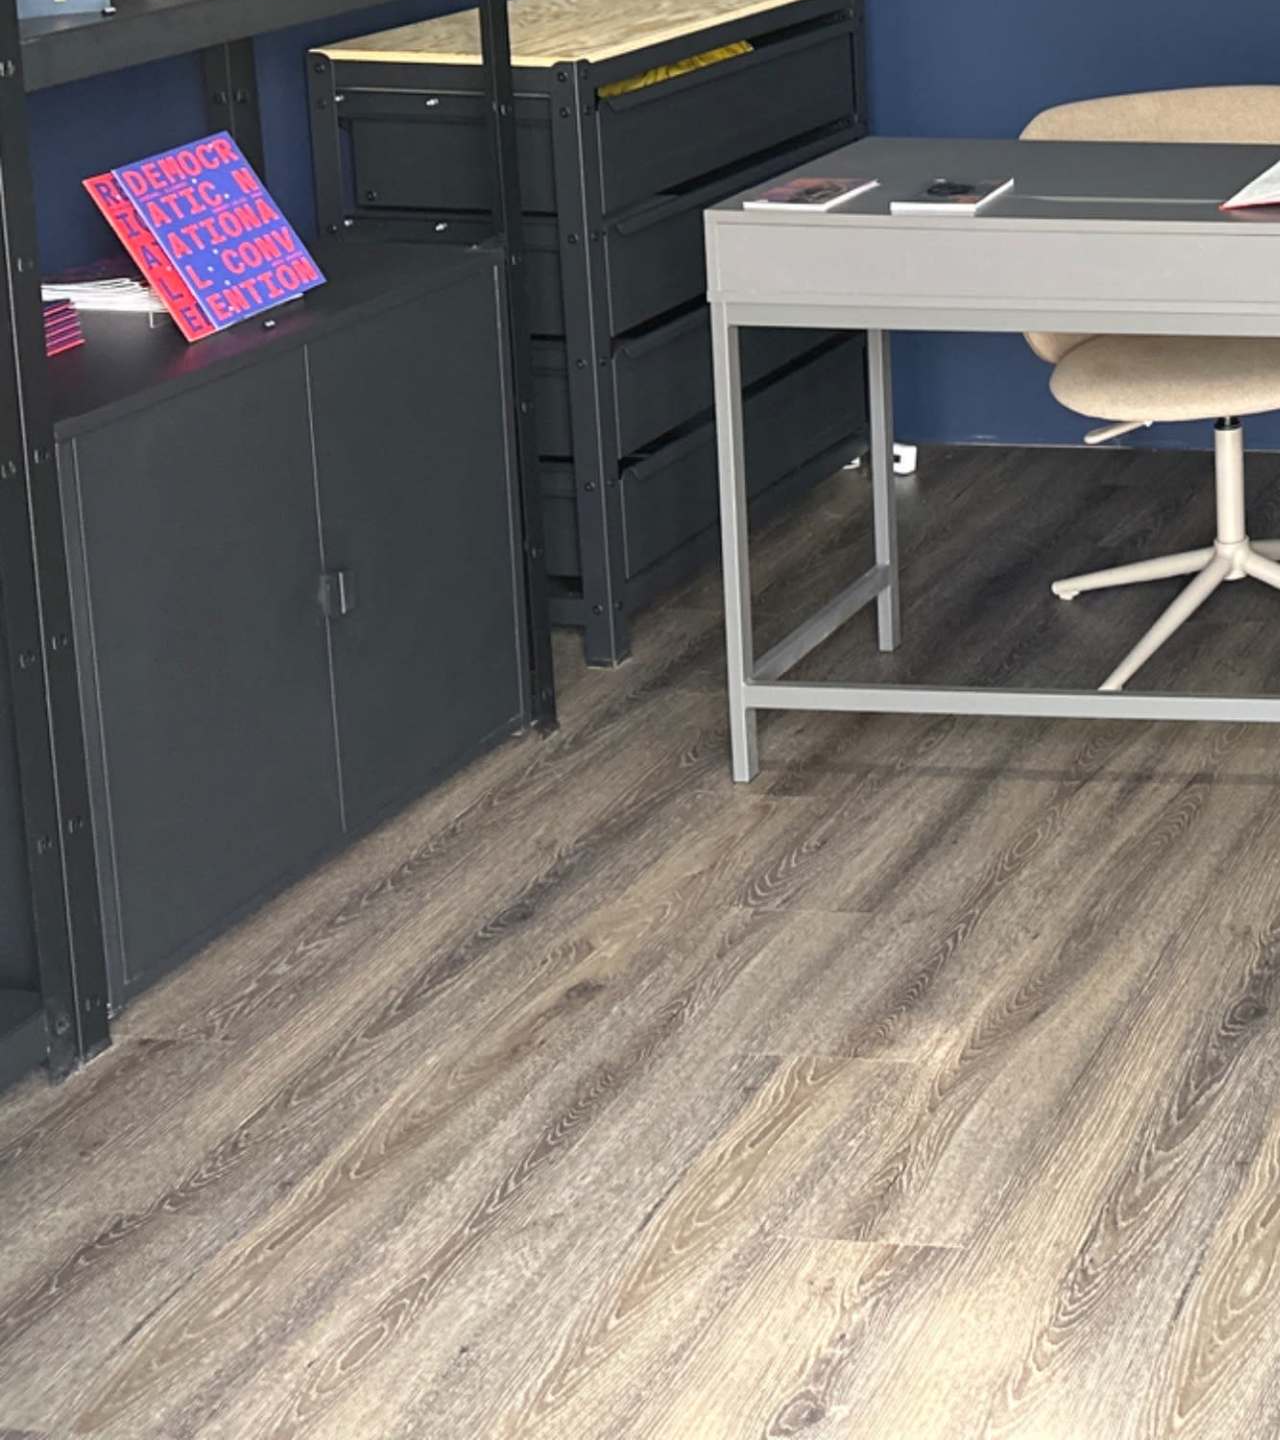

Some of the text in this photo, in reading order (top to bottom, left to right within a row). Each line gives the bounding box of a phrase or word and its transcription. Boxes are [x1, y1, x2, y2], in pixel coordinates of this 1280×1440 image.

[121, 138, 239, 197] DEMOCR
[167, 198, 280, 259] ATIONA
[221, 226, 297, 274] CONV
[206, 255, 319, 321] ENTION
